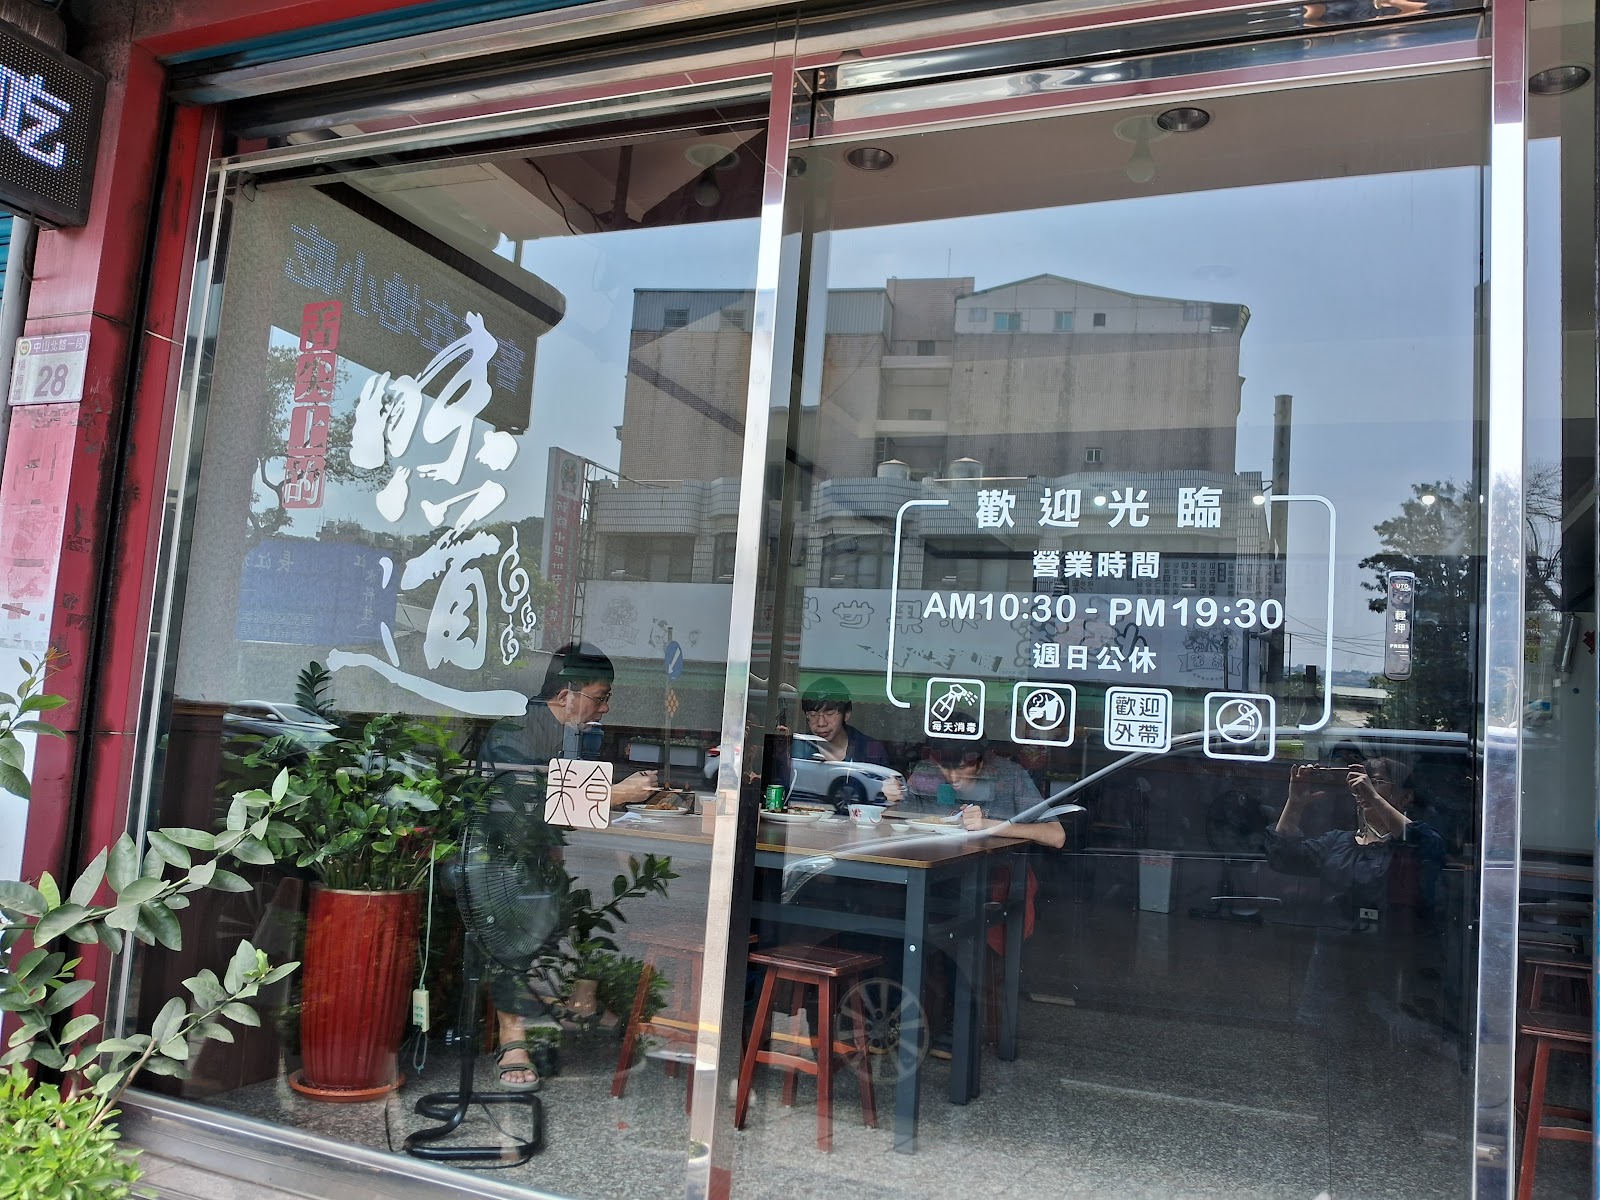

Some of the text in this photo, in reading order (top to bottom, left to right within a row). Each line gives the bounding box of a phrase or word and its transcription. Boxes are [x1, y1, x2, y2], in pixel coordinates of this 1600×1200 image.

[33, 337, 84, 353] 中山北路一段
[33, 363, 69, 397] 28
[283, 301, 341, 508] 舌尖上的
[976, 486, 1223, 529] 歡迎光臨
[1032, 549, 1160, 579] 營業時間
[922, 591, 1077, 624] AM10:30
[1394, 610, 1407, 634] 輕押
[1033, 642, 1158, 674] 週日公休
[1115, 696, 1160, 717] 歡迎
[932, 721, 977, 733] 每天消毒
[1115, 722, 1160, 744] 外帶
